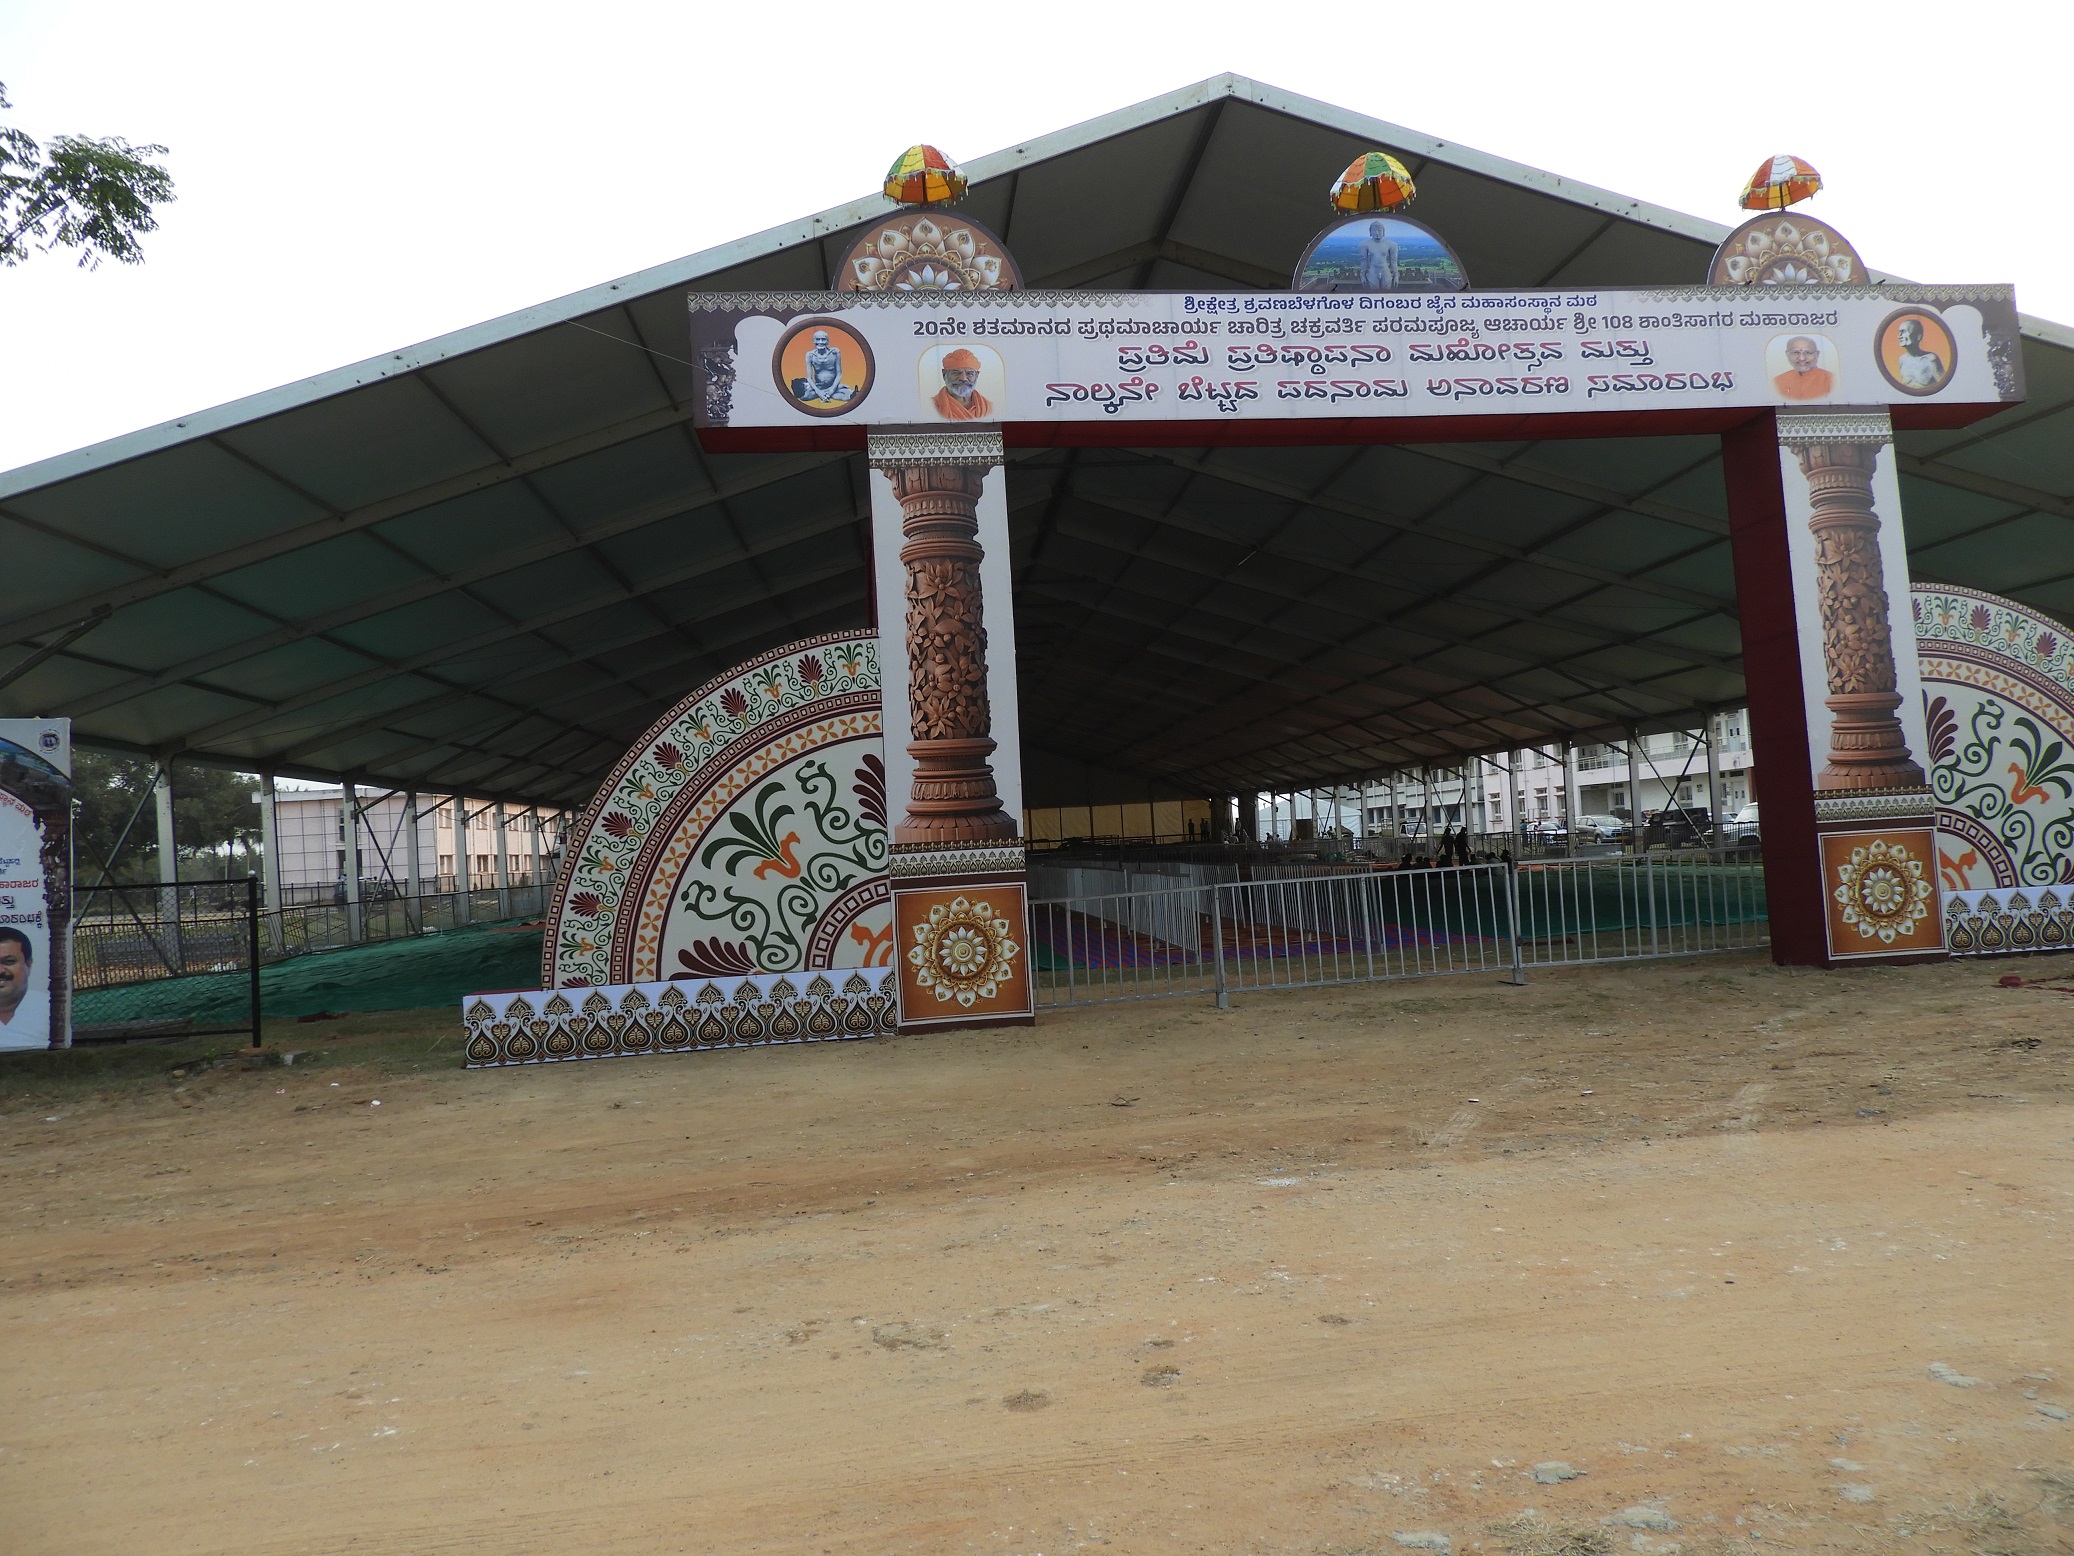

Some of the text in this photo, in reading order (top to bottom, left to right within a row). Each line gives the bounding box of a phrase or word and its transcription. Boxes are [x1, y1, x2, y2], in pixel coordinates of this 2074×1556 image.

[1184, 294, 1597, 315] ಶ್ರೀಕ್ಷೇತ್ರ ಶ್ರವಣಬೆಳಗೊಳ ದಿಗಂಬರ ಜೈನ ಮಹಾಸಂಸ್ಥಾನ ಮಠ
[913, 310, 1838, 339] 20ನೇ ಶತಮಾನದ ಪ್ರಥಮಾಚಾರ್ಯ ಚಾರಿತ್ರ ಚಕ್ರವರ್ತಿ ಪರಮಪೂಜ್ಯ ಆಚಾರ್ಯ ಶ್ರೀ 108 ಶಾಂತಿಸಾಗರ ಮಹಾರಾಜರ
[1118, 337, 1654, 374] ಪ್ರತಿಮೆ ಪ್ರತಿಷ್ಠಾಪನಾ ಮಹೋತ್ಸವ ಮತ್ತು
[1045, 371, 1735, 414] ನಾಲ್ಕನೇ ಬೆಟ್ಟದ ಪದನಾಮ ಅನಾವರಣ ಸಮಾರಂಭ
